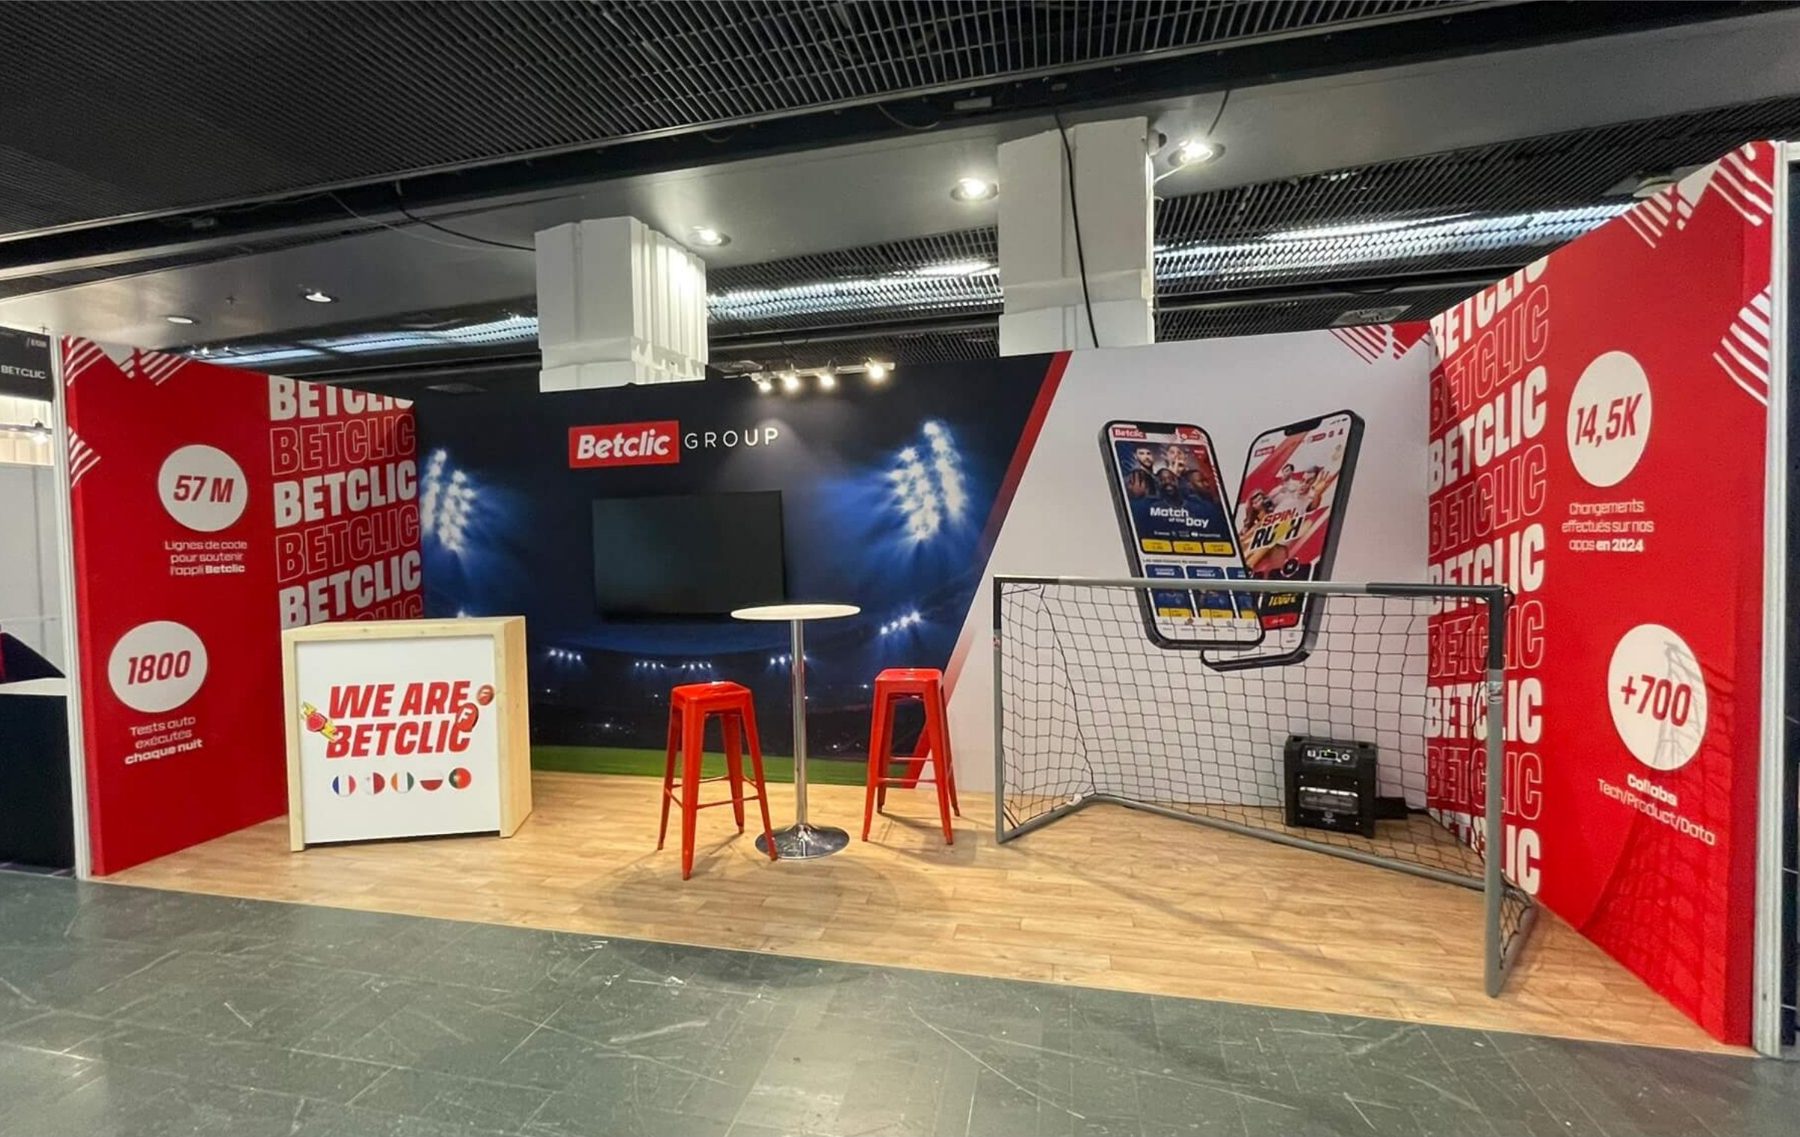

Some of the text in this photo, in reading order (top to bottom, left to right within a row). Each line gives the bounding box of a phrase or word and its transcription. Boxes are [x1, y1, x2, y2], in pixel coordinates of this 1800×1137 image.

[1, 365, 46, 380] BETCLIC
[1430, 284, 1549, 435] BETCLIC
[269, 375, 414, 421] BETC
[1429, 365, 1547, 497] BETCLIC
[1575, 393, 1643, 447] 14,5K
[270, 413, 416, 476] BETCLIC
[577, 427, 780, 459] Betclic GROUP
[173, 475, 234, 503] 57 M
[273, 460, 418, 529] BETCLIC
[1428, 443, 1546, 558] BETCLIC
[1569, 498, 1645, 516] Changements
[1150, 506, 1189, 517] Match
[1186, 517, 1210, 529] Day
[1612, 520, 1630, 533] sur
[1631, 520, 1655, 533] nos
[164, 540, 248, 551] Lignes de code
[275, 504, 420, 583] BETCLIC
[1250, 516, 1303, 550] RUH
[1568, 538, 1644, 553] apps en 2024
[170, 552, 244, 564] pour soutenir
[205, 564, 246, 574] Betclic
[1428, 523, 1545, 615] BETCLIC
[279, 550, 421, 630] BETCLIC
[1428, 600, 1545, 679] BETCIC
[127, 650, 192, 685] 1800
[328, 680, 471, 719] WE ARE
[1426, 677, 1542, 744] BETCIC
[1621, 674, 1692, 727] +700
[130, 716, 196, 737] Tests auto
[326, 719, 471, 759] BETCLIC
[124, 738, 203, 765] chaque nuit
[1427, 745, 1542, 820] BETCIC
[1627, 773, 1678, 807] Collabs
[1597, 778, 1716, 846] Tech/Product/Data
[1428, 807, 1541, 895] TCIC
